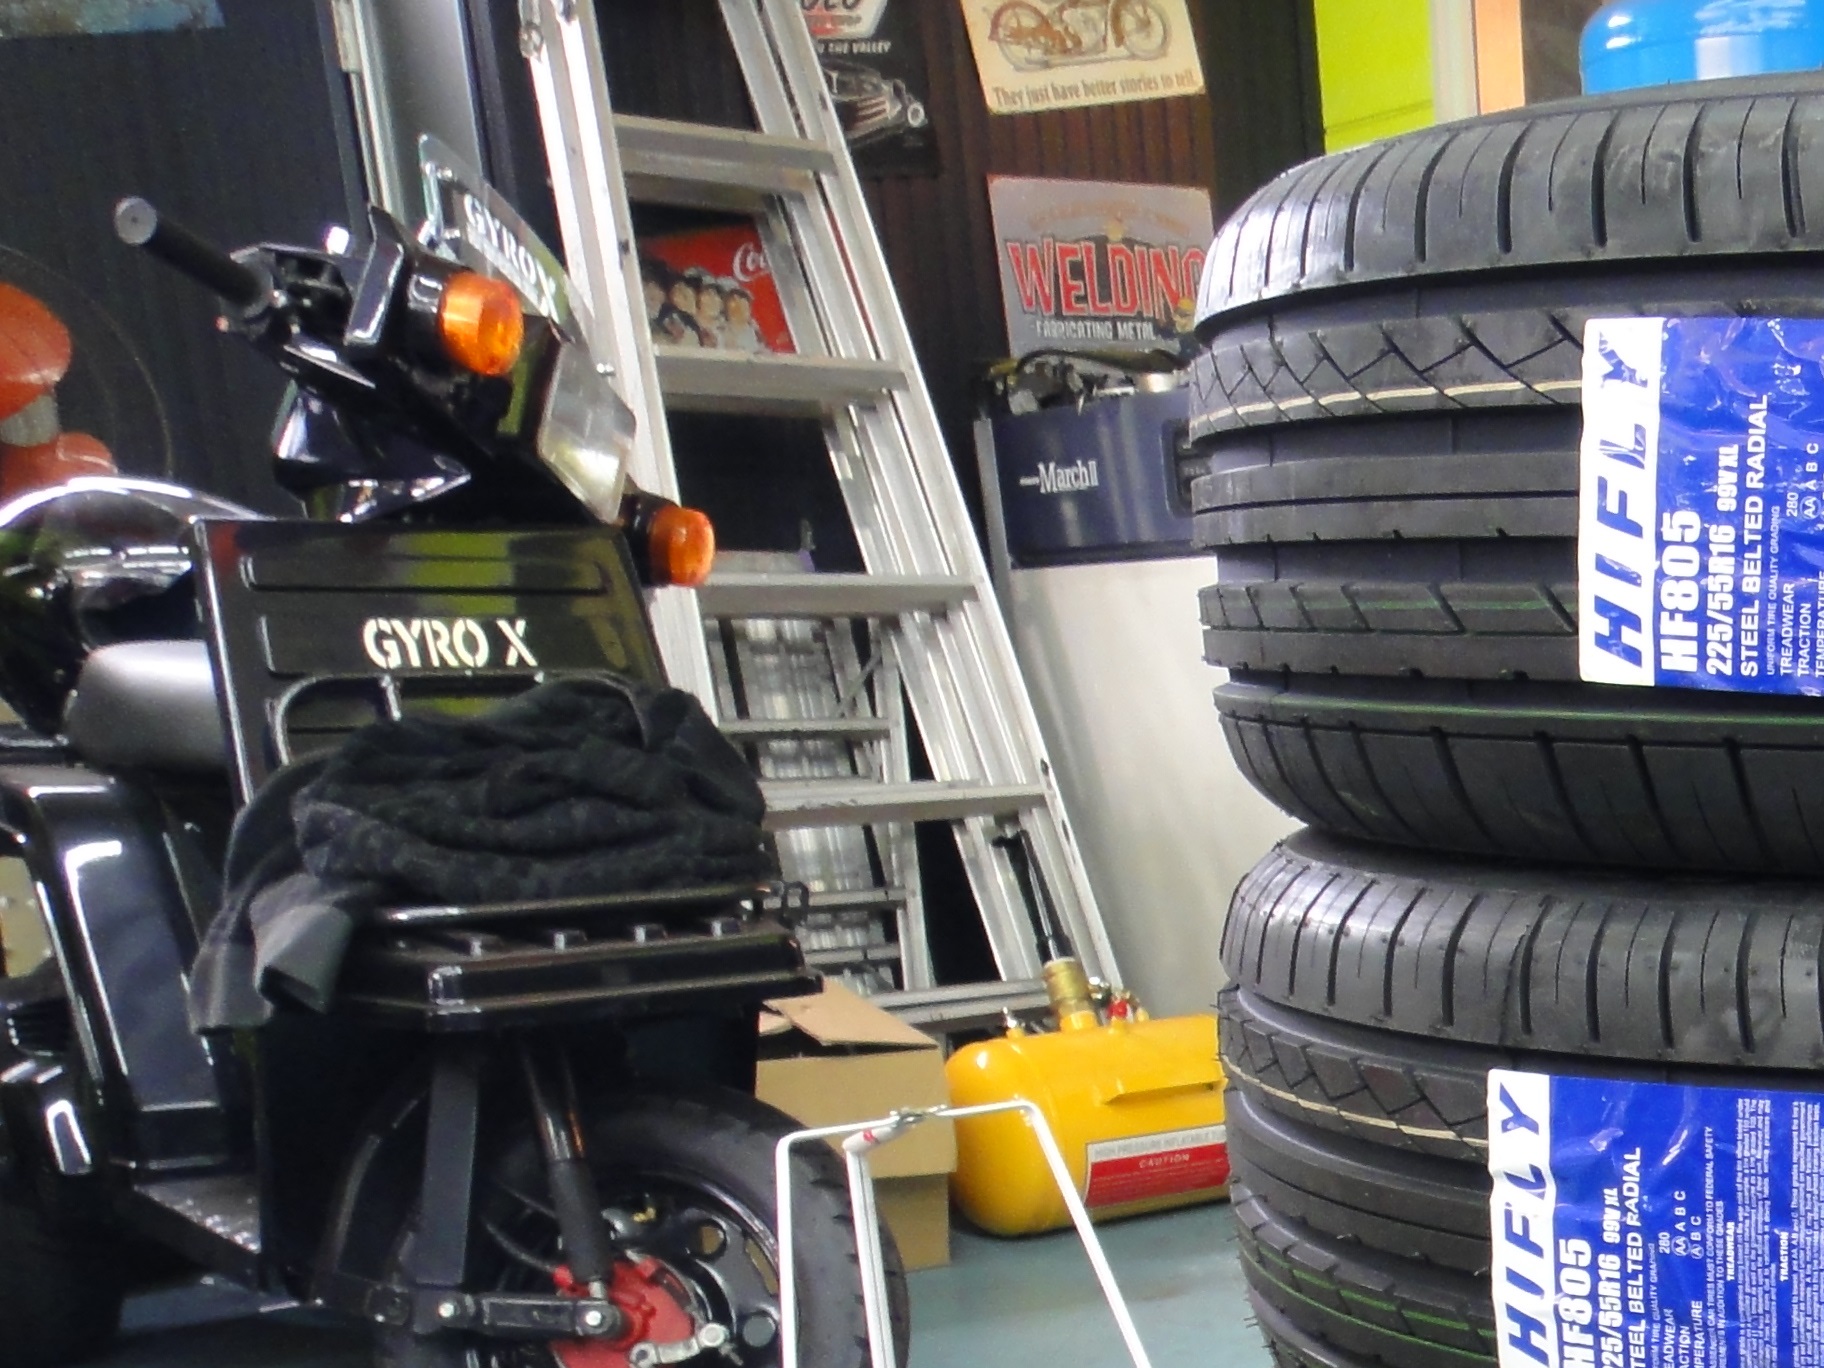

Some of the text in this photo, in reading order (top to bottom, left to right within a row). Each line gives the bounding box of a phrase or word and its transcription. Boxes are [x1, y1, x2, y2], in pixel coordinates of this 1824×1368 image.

[993, 86, 1023, 107] They
[1026, 84, 1050, 105] just
[1051, 82, 1080, 101] have
[1081, 78, 1116, 98] better
[1119, 75, 1158, 95] stories
[1160, 73, 1174, 90] to
[464, 193, 537, 285] GYRO
[1036, 320, 1156, 341] FABRICATING METAL
[1806, 462, 1818, 472] B
[1807, 443, 1819, 455] C
[1594, 332, 1648, 669] HIFLY
[1740, 394, 1768, 677] STEEL BELTED RADIAL
[1770, 505, 1781, 554] GRADING
[1660, 510, 1702, 673] HF805
[1705, 523, 1736, 676] 225/55R16
[1768, 556, 1780, 600] QUALITY
[1780, 492, 1799, 677] TREADWEAR 280
[362, 616, 539, 670] GYRO X
[1797, 602, 1812, 678] TRACTION
[1139, 1153, 1190, 1169] CAUTION
[1622, 1147, 1641, 1227] RADIAL
[1674, 1190, 1686, 1201] C
[1674, 1206, 1686, 1217] B
[1499, 1082, 1551, 1368] HIFLY
[1658, 1231, 1671, 1255] 280
[1674, 1221, 1687, 1232] A
[1690, 1215, 1702, 1226] C
[1690, 1231, 1702, 1241] B
[1626, 1231, 1645, 1314] BELTED
[1726, 1221, 1736, 1281] TREADWEAR
[1779, 1231, 1789, 1282] TRACTION
